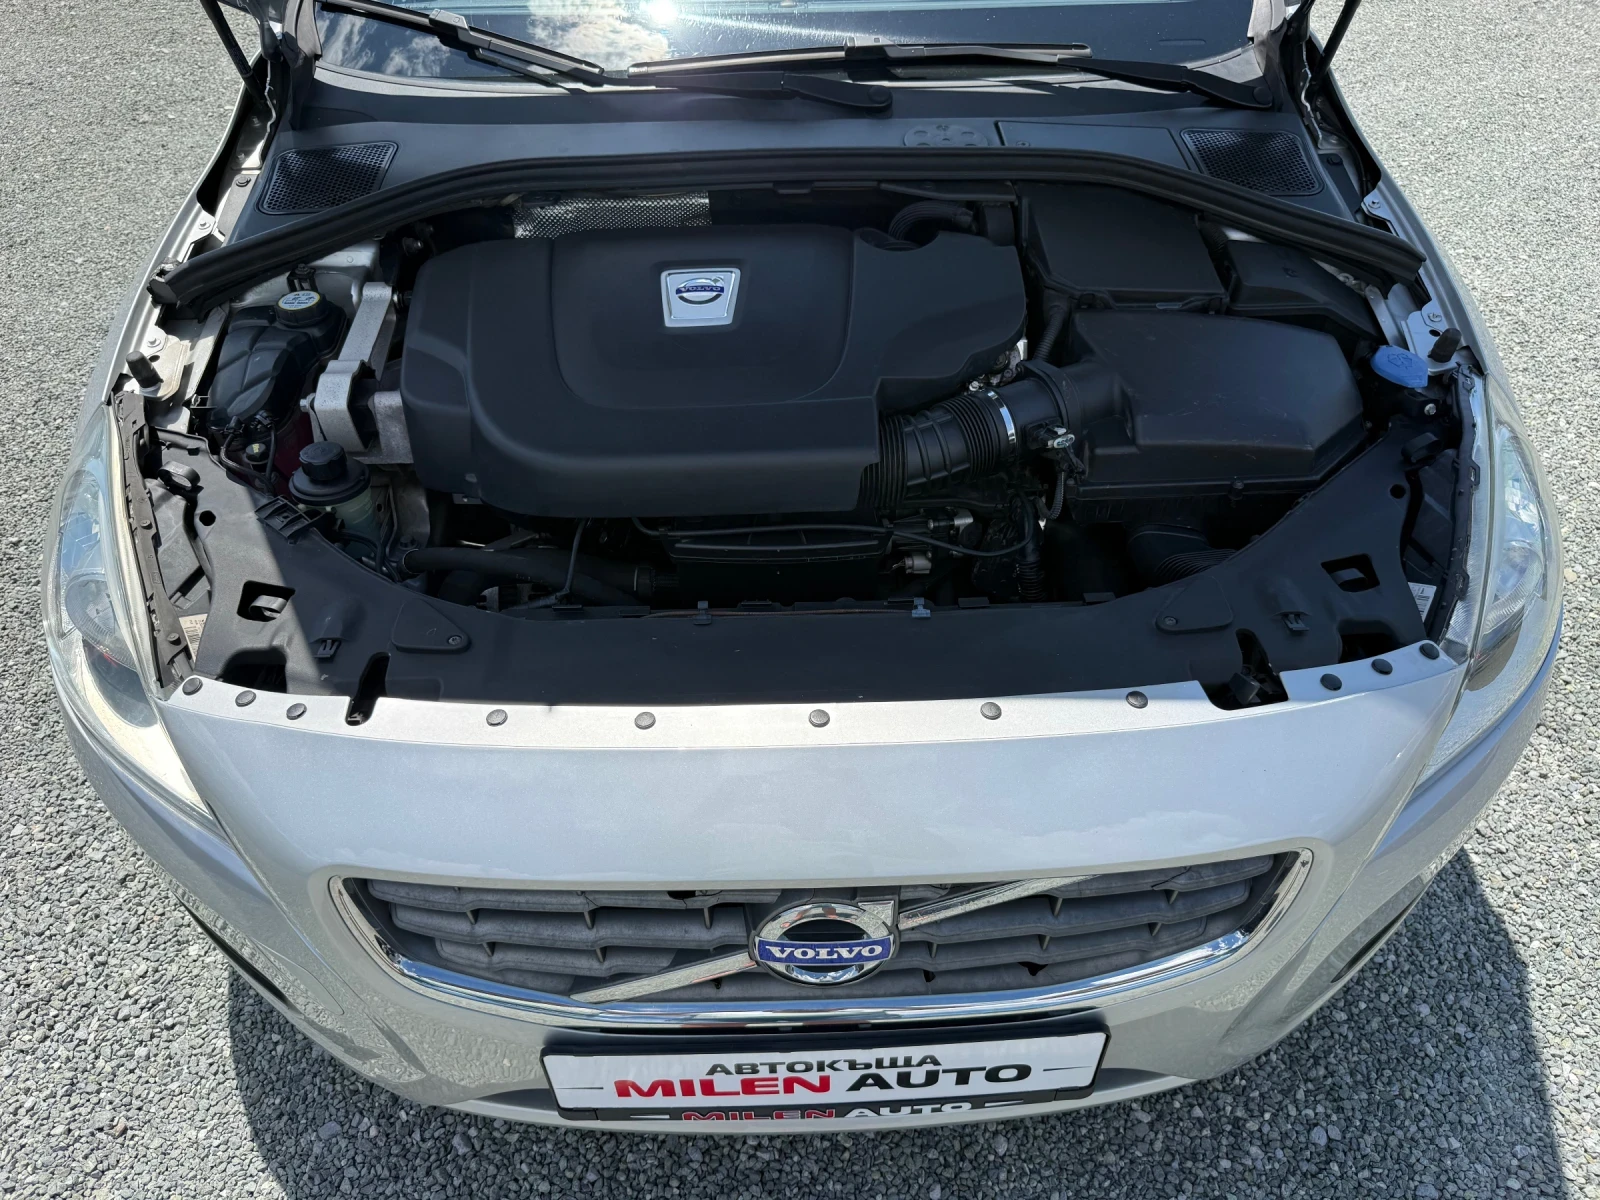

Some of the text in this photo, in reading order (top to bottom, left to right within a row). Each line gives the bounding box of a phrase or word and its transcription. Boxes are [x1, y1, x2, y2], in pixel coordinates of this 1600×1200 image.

[765, 945, 883, 960] VOLVO
[705, 1054, 942, 1076] АВТОКЪША
[613, 1064, 1032, 1098] MILEN AUTO
[682, 1101, 972, 1121] MILEN AUTO
